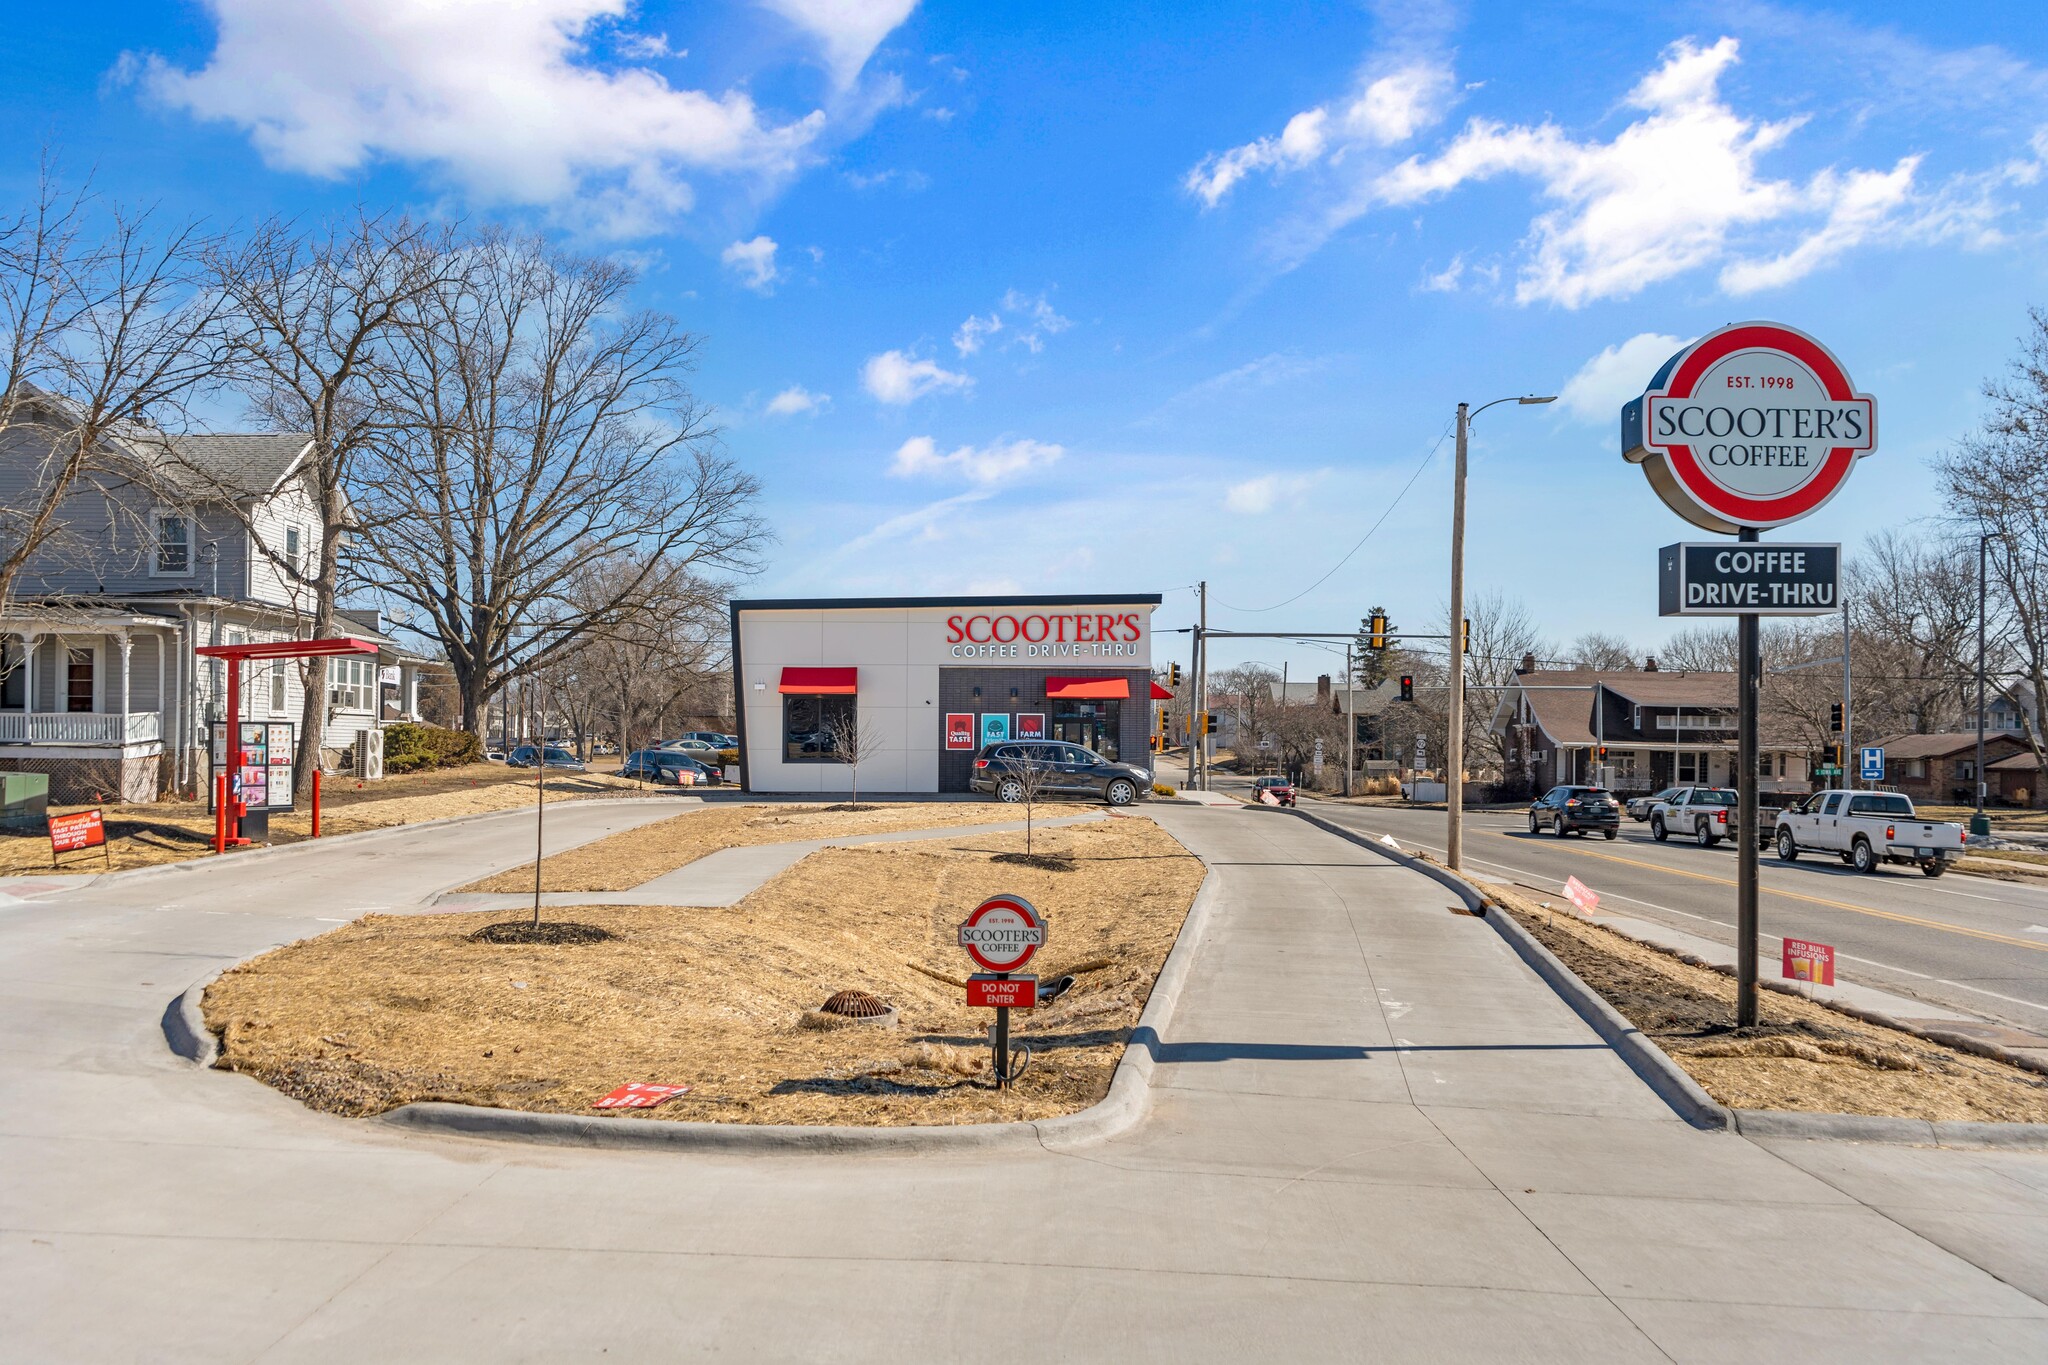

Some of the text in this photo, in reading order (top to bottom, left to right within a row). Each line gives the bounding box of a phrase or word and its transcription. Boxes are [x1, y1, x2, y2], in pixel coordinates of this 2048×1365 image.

[1727, 376, 1794, 389] EST. 1998
[1658, 405, 1863, 440] SCOOTER'S
[1708, 444, 1809, 468] COFFEE
[1714, 551, 1806, 574] COFFEE
[1687, 582, 1834, 605] DRIVE-THRU
[946, 614, 1141, 644] SCOOTER'S
[951, 643, 1138, 658] COFFEE DRIVE-THRU
[1864, 749, 1881, 769] H
[52, 821, 101, 834] FAST PAYMENT
[53, 829, 87, 840] THROUGH
[54, 838, 70, 846] OUR
[963, 929, 1040, 942] SCOOTER'S
[981, 943, 1020, 953] COFFEE
[1791, 941, 1826, 954] RED BULL
[1787, 948, 1830, 962] INFUSIONS
[981, 983, 1020, 993] DO NOT
[986, 994, 1015, 1004] ENTER
